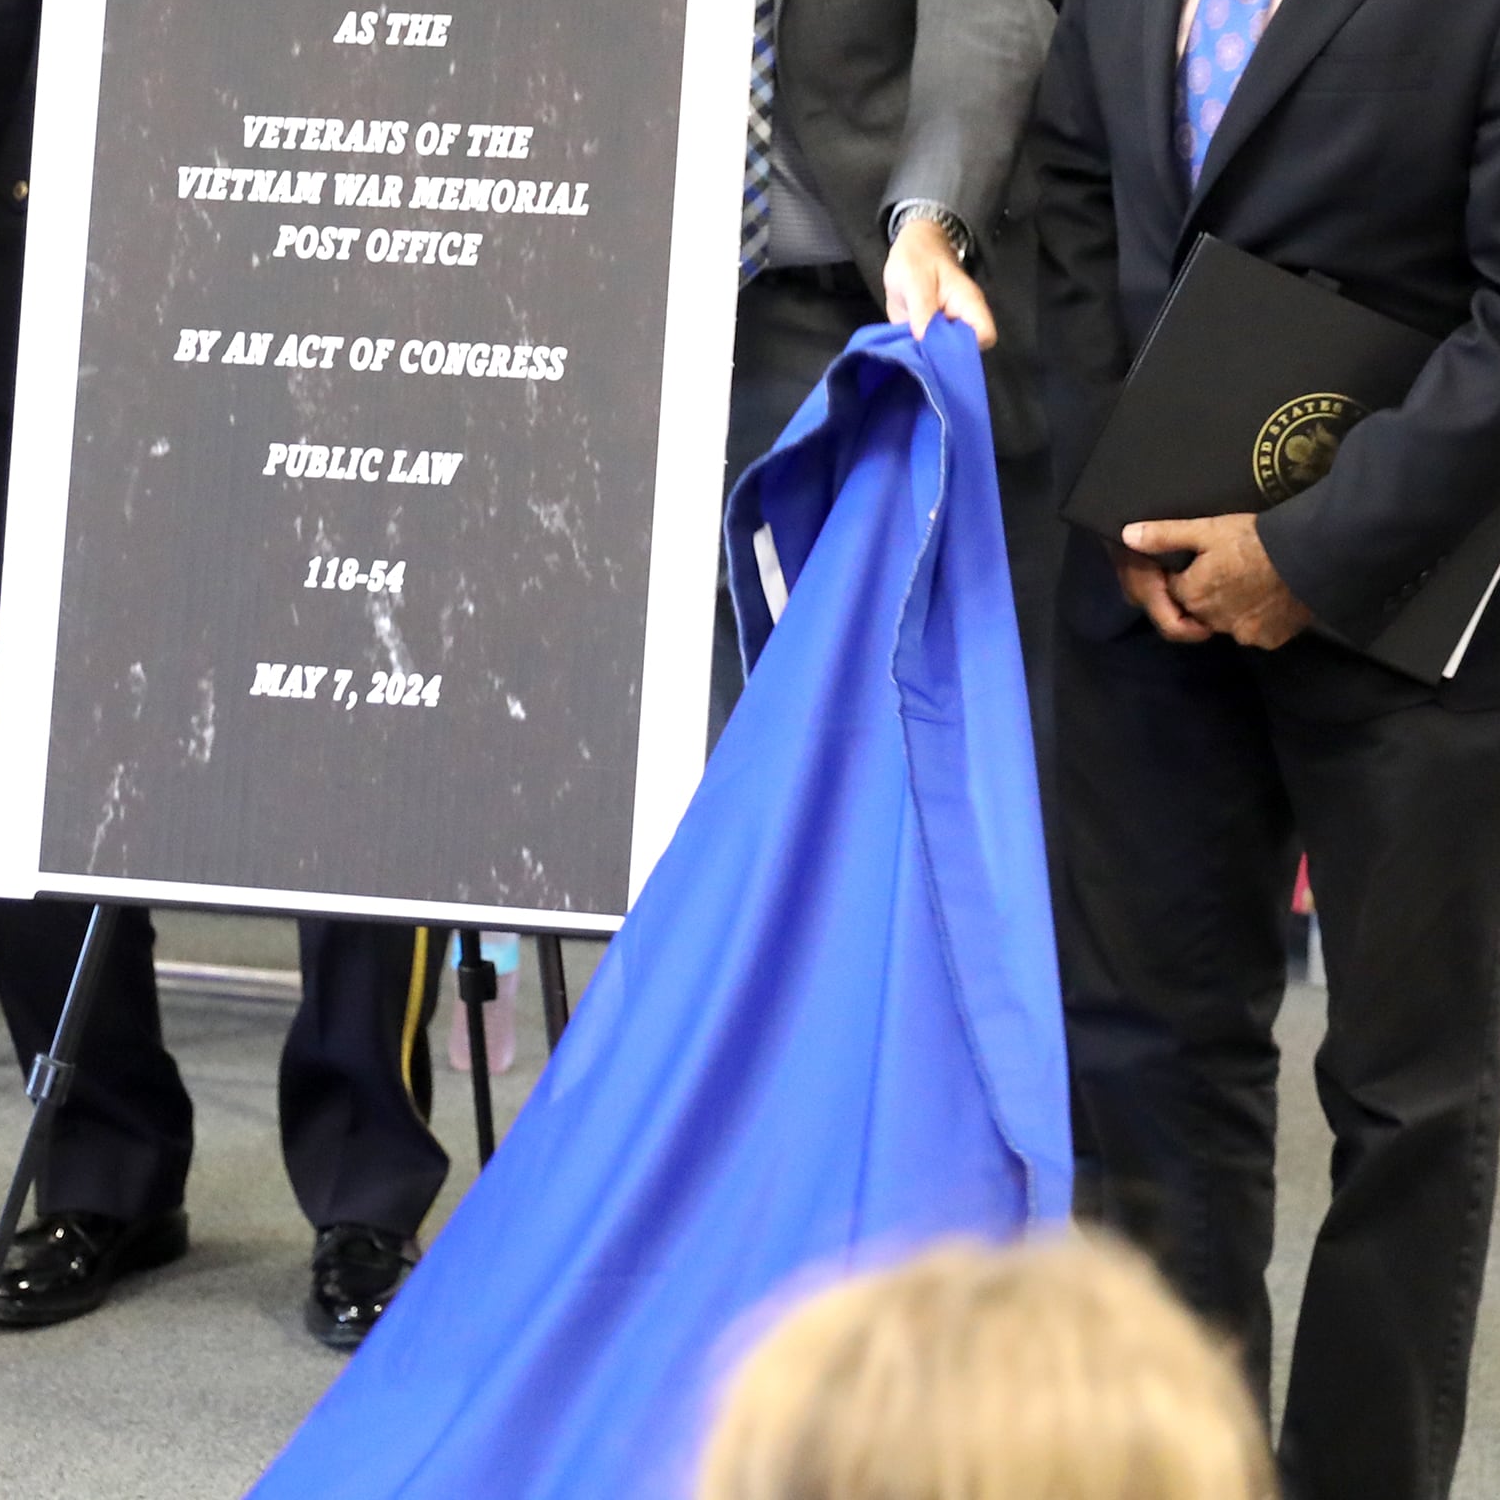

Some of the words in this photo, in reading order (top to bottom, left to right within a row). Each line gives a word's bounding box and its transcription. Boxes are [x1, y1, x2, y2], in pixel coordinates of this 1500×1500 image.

[333, 12, 378, 45] AS
[384, 13, 451, 47] THE
[242, 116, 409, 157] VETERANS
[414, 122, 461, 157] OF
[467, 124, 533, 160] THE
[177, 166, 325, 207] VIETNAM
[333, 174, 402, 208] WAR
[409, 176, 590, 217] MEMORIAL
[273, 225, 359, 261] POST
[364, 228, 482, 266] OFFICE
[174, 330, 220, 363] BY
[223, 333, 272, 365] AN
[275, 336, 345, 369] ACT
[349, 338, 396, 371] OF
[400, 341, 568, 381] CONGRESS
[1269, 400, 1342, 436] STATES
[263, 444, 383, 482] PUBLIC
[389, 449, 462, 485] LAW
[304, 557, 406, 593] 118-54
[250, 663, 328, 698] MAY
[332, 668, 359, 710] 7,
[366, 672, 442, 707] 2024
